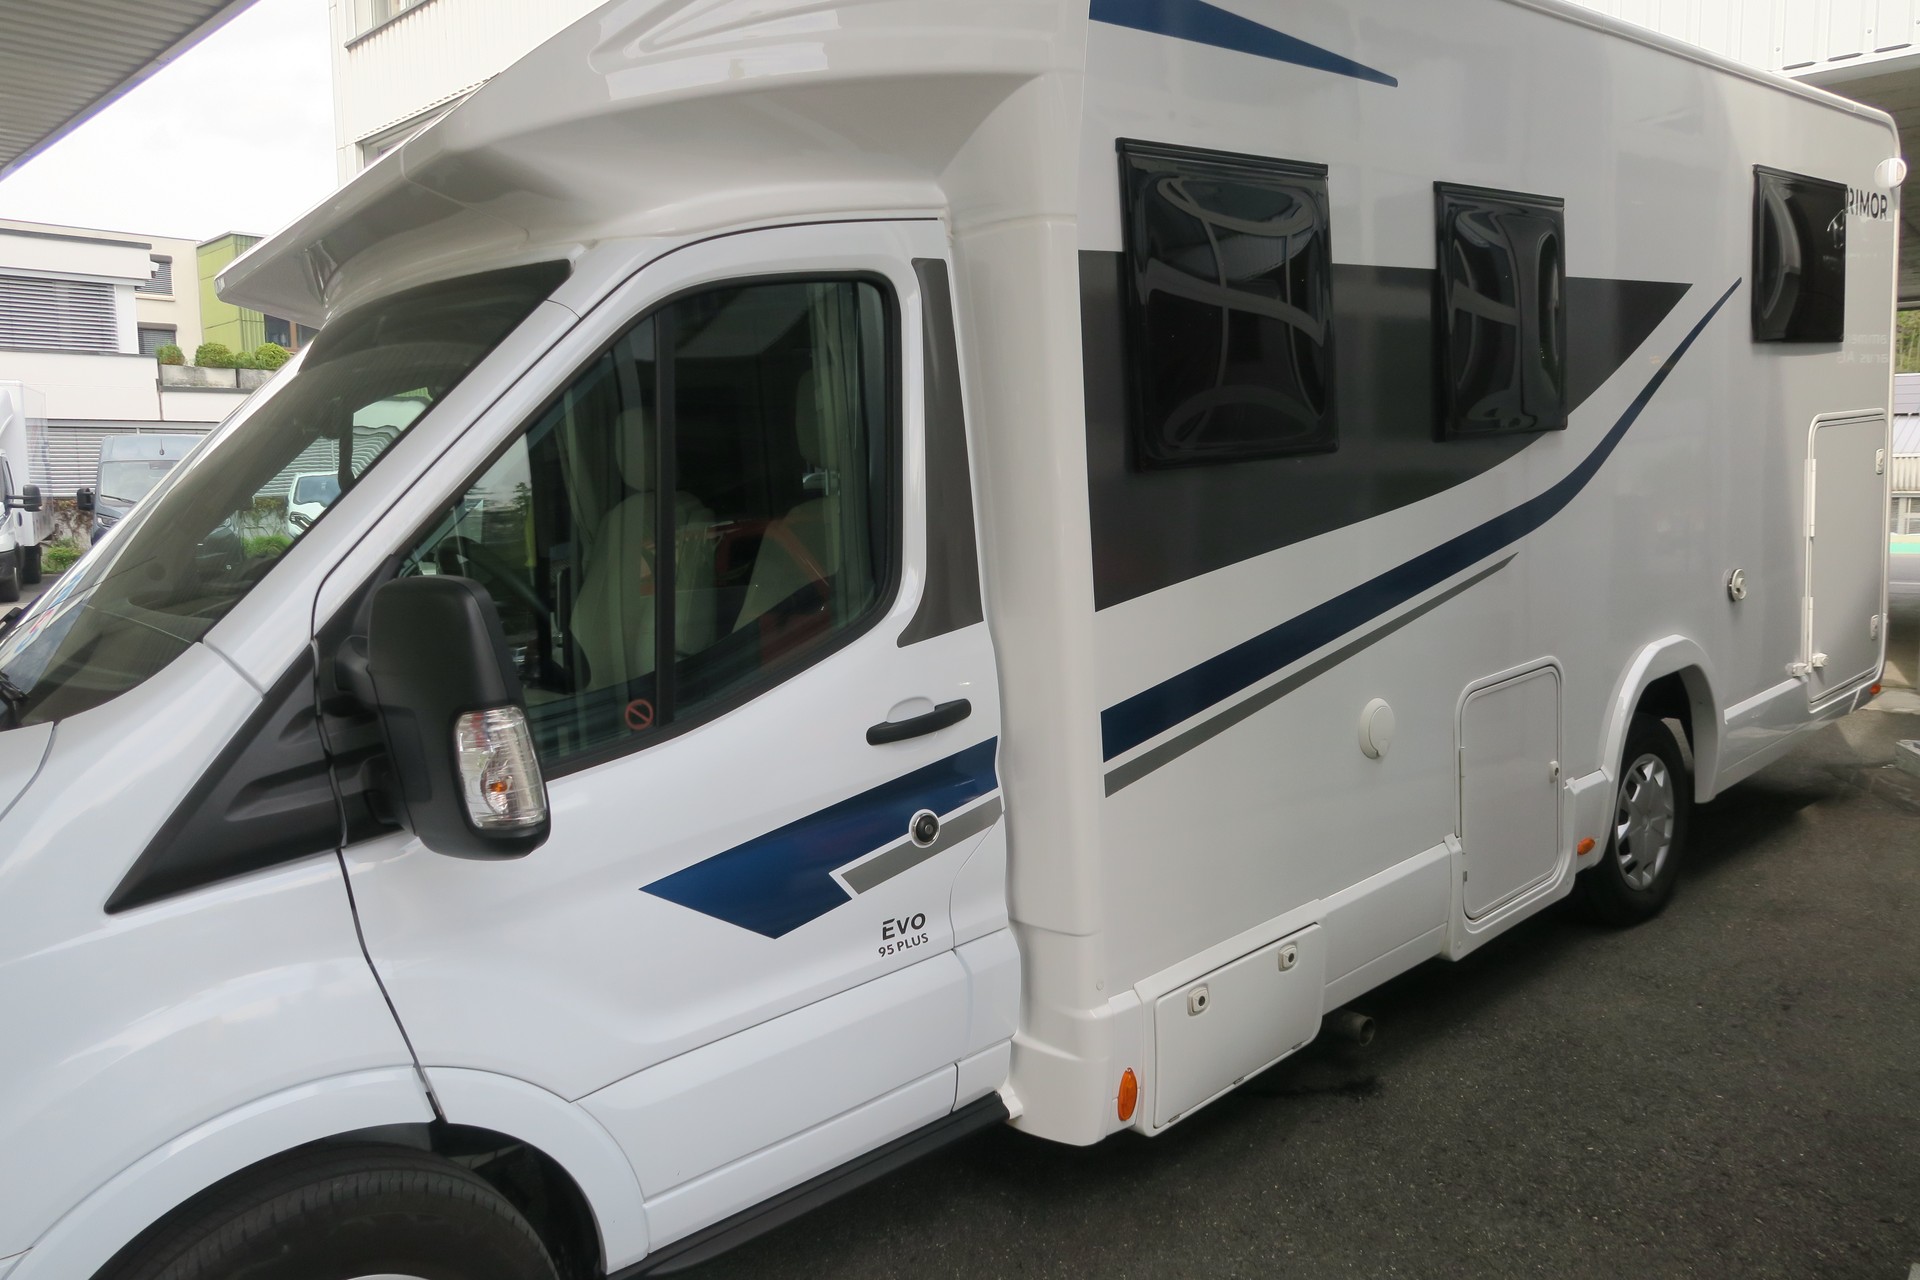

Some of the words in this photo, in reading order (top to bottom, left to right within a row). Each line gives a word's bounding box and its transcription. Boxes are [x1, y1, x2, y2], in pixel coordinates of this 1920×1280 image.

[1846, 187, 1888, 220] RIMOR
[882, 912, 926, 941] EVO
[878, 944, 895, 958] 95
[896, 932, 929, 952] PLUS
